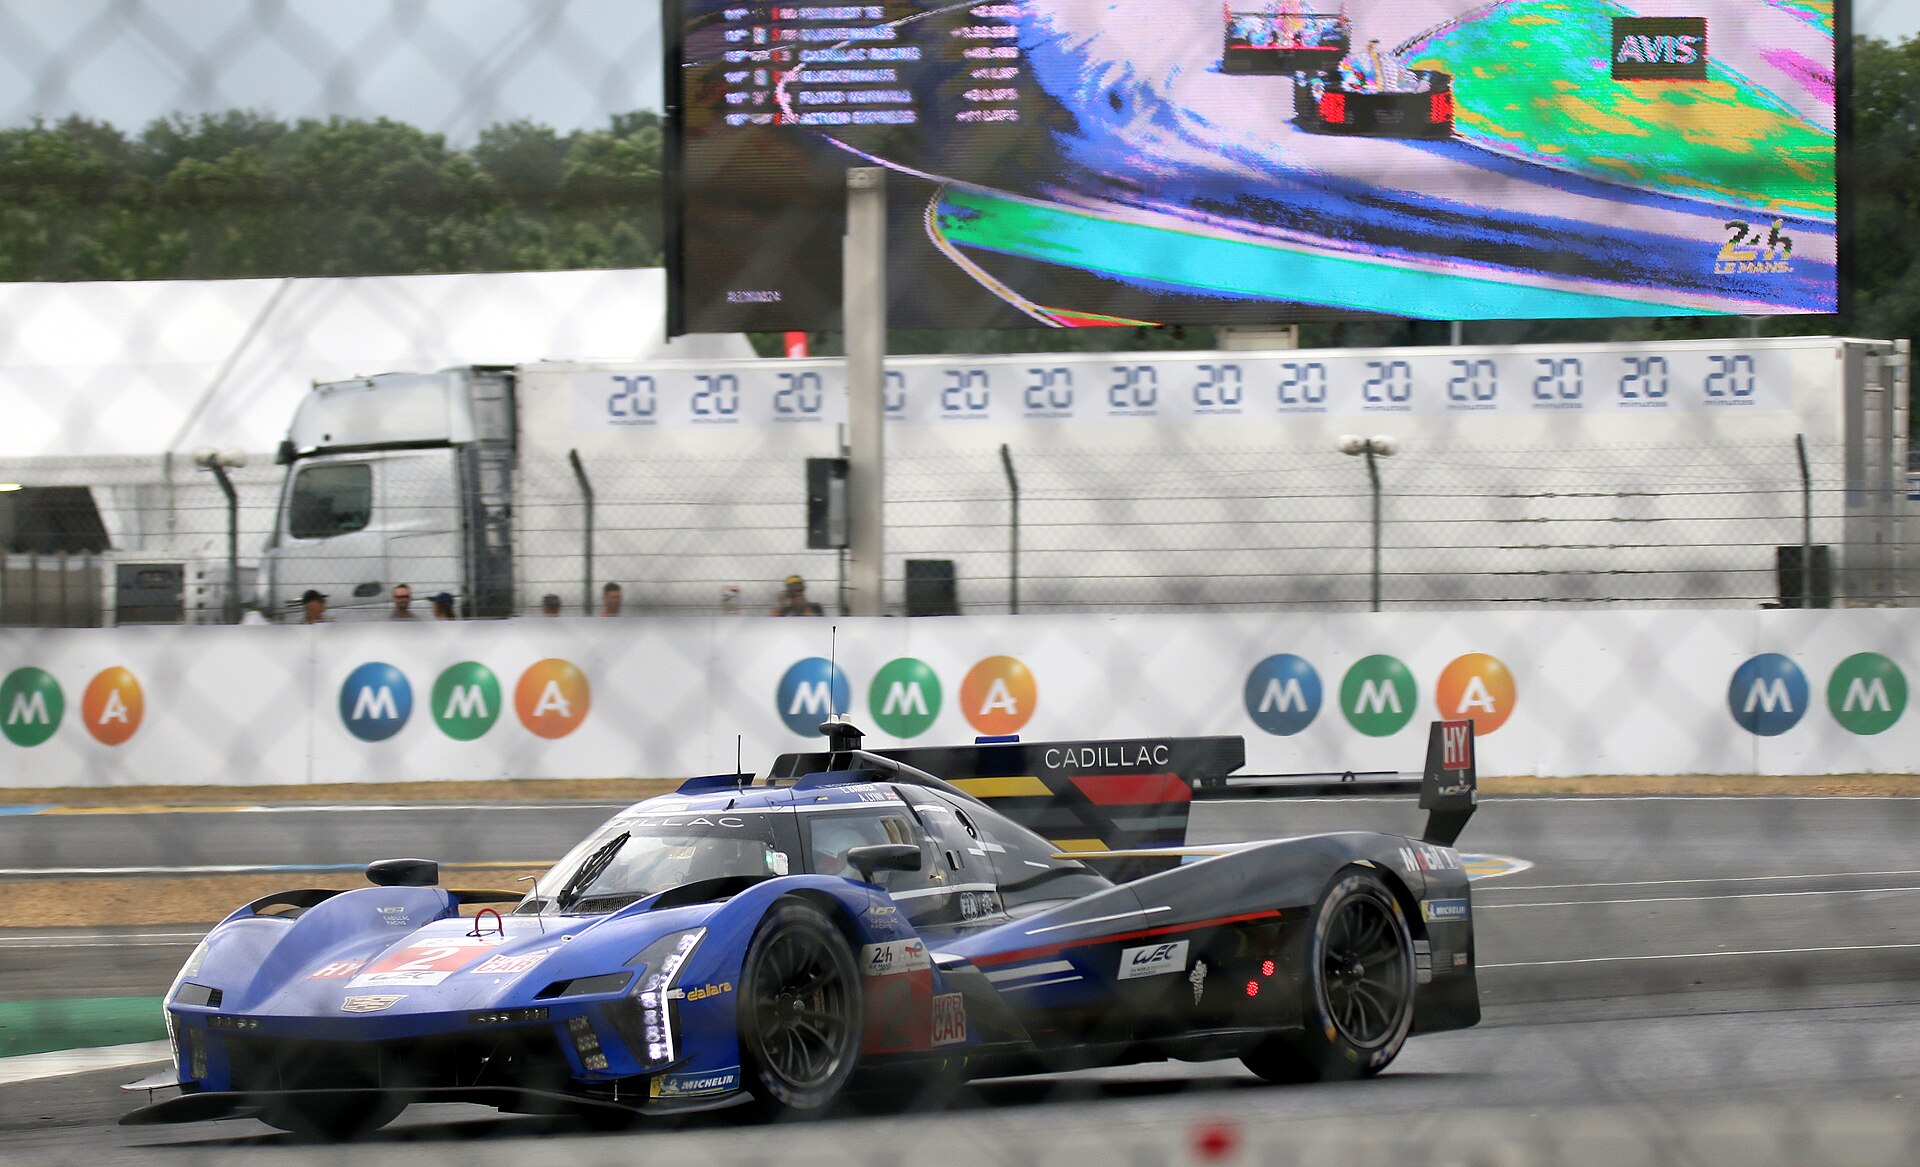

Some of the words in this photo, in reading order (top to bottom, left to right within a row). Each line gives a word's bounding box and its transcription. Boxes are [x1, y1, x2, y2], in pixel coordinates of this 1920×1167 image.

[1617, 35, 1702, 63] AVIS
[608, 376, 656, 417] 20
[692, 374, 739, 414] 20
[774, 372, 821, 413] 20
[941, 370, 989, 410] 20
[1025, 368, 1072, 409] 20
[1109, 366, 1156, 407] 20
[1193, 364, 1242, 406] 20
[1278, 363, 1326, 404] 20
[1363, 361, 1411, 402] 20
[1447, 359, 1497, 401] 20
[1533, 358, 1582, 400] 20
[1619, 356, 1668, 398] 20
[1704, 355, 1754, 396] 20
[8, 691, 49, 724] M
[100, 690, 128, 724] A
[352, 685, 399, 720] M
[443, 684, 488, 719] M
[533, 680, 571, 718] A
[788, 681, 835, 716] M
[881, 681, 929, 715] M
[979, 677, 1018, 715] A
[1259, 678, 1307, 713] M
[1354, 679, 1403, 714] M
[1457, 676, 1495, 714] A
[1743, 677, 1793, 713] M
[1842, 677, 1891, 712] M
[1045, 744, 1169, 769] CADILLAC
[1443, 726, 1467, 763] HY
[393, 947, 461, 971] 2
[1132, 943, 1179, 965] WEC
[687, 982, 732, 1001] dallara
[933, 1011, 965, 1041] CAR
[681, 1075, 734, 1090] MICHELIN
